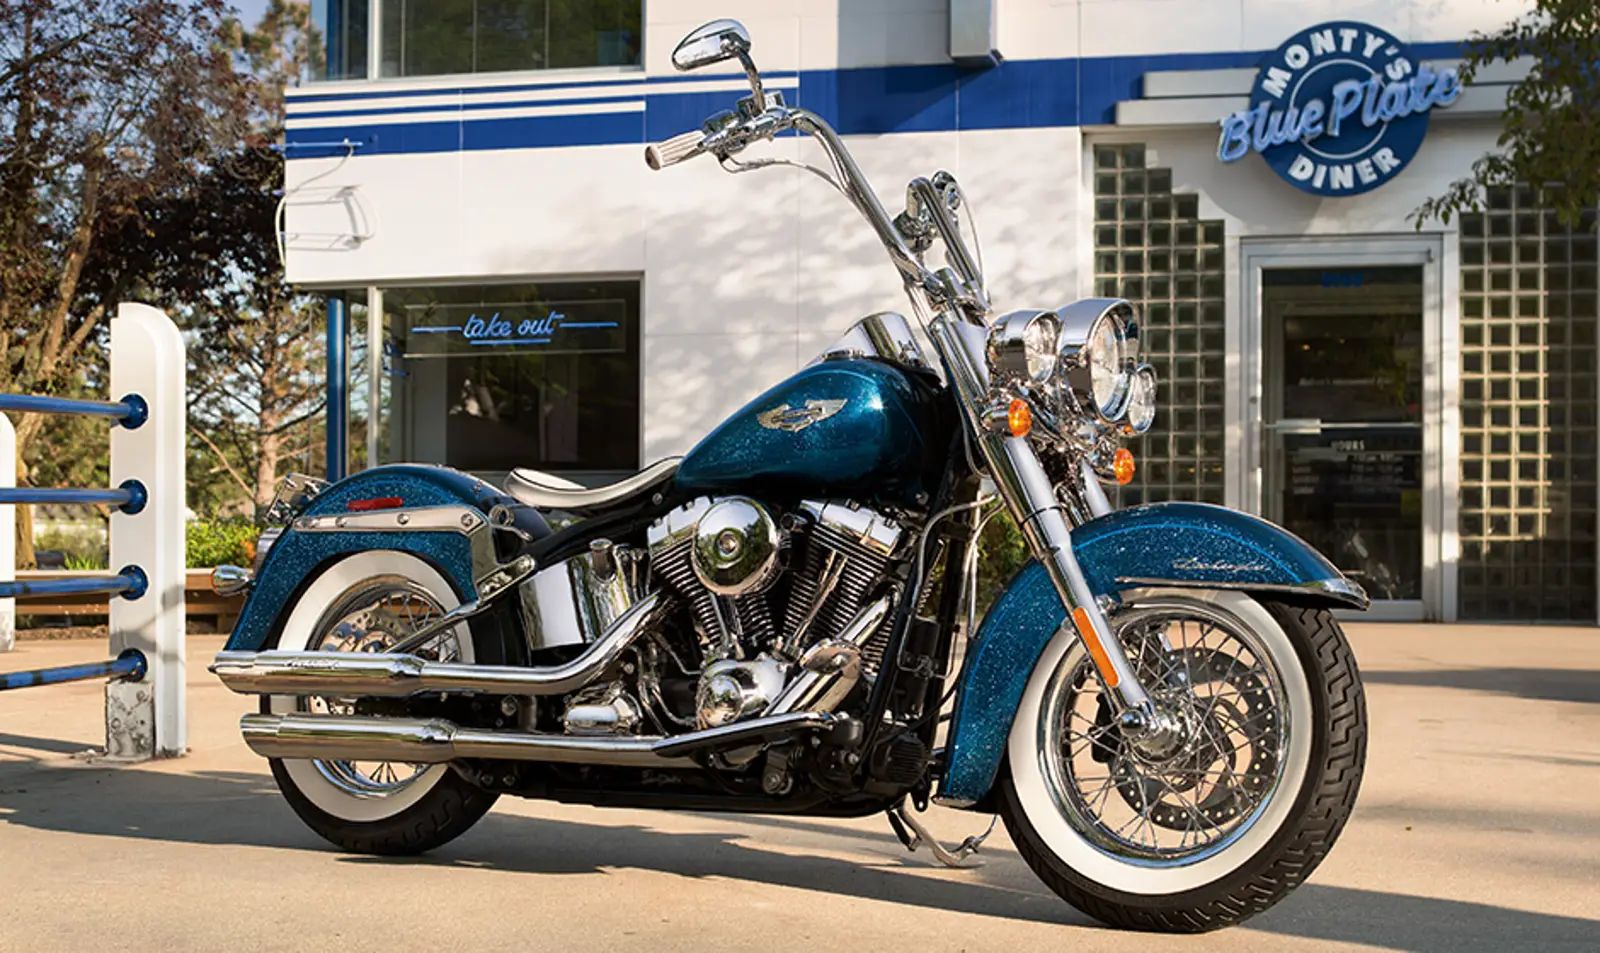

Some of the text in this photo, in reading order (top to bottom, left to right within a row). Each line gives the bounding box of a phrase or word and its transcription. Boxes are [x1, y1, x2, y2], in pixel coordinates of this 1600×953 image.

[1262, 28, 1412, 98] MONTY'S
[1217, 62, 1462, 161] Blue Plate
[1288, 147, 1400, 189] DINER
[463, 310, 565, 338] take out
